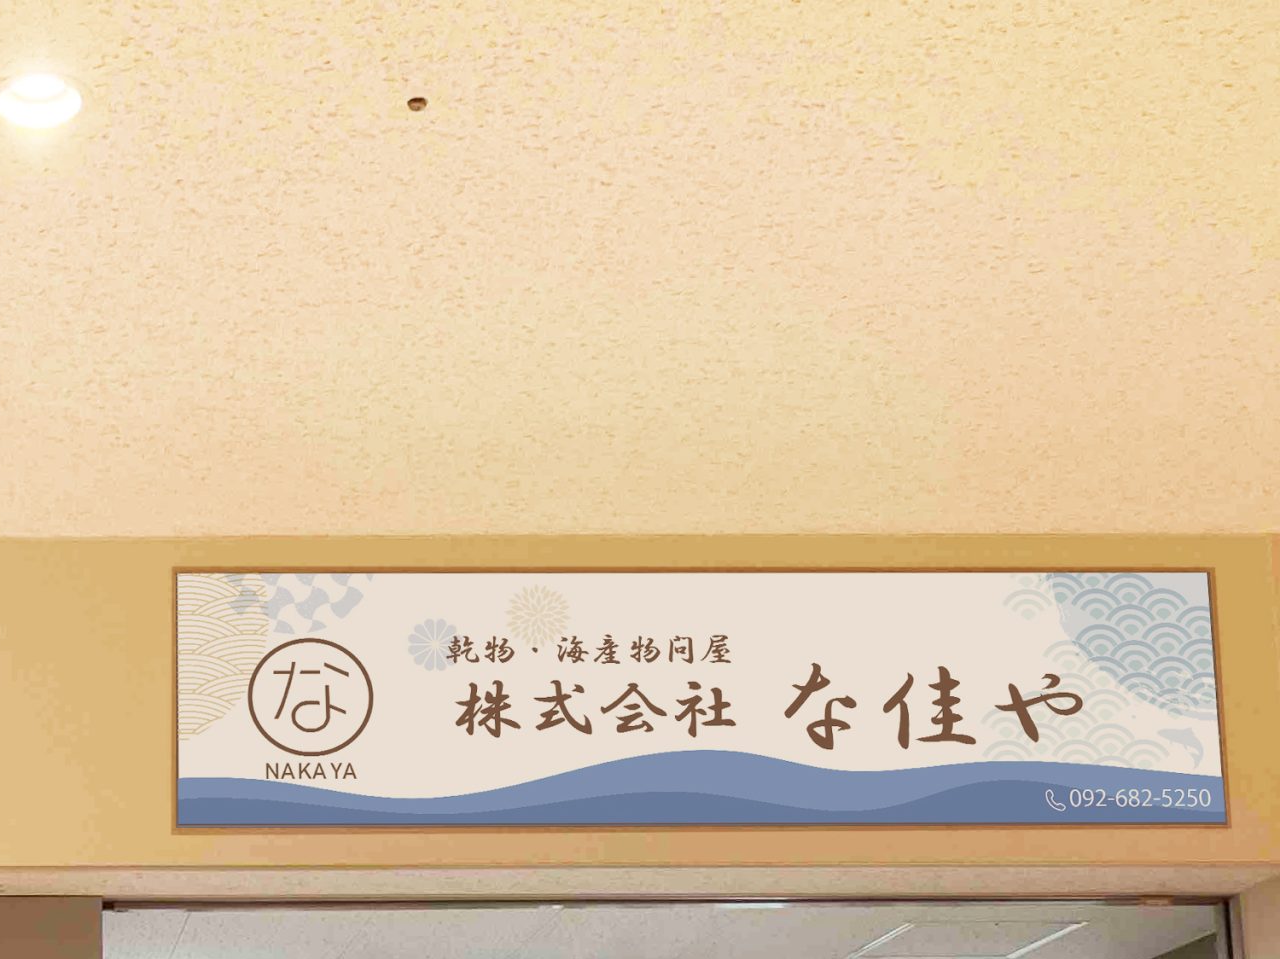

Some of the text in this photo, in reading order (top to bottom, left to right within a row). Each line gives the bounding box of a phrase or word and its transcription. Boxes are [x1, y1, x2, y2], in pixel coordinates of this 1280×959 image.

[446, 635, 732, 665] 乾物・海産物問屋
[273, 661, 349, 733] な
[455, 662, 1083, 750] 株式会社 な佳や
[266, 763, 357, 780] NAKAYA
[1069, 788, 1212, 808] 092-682-5250
